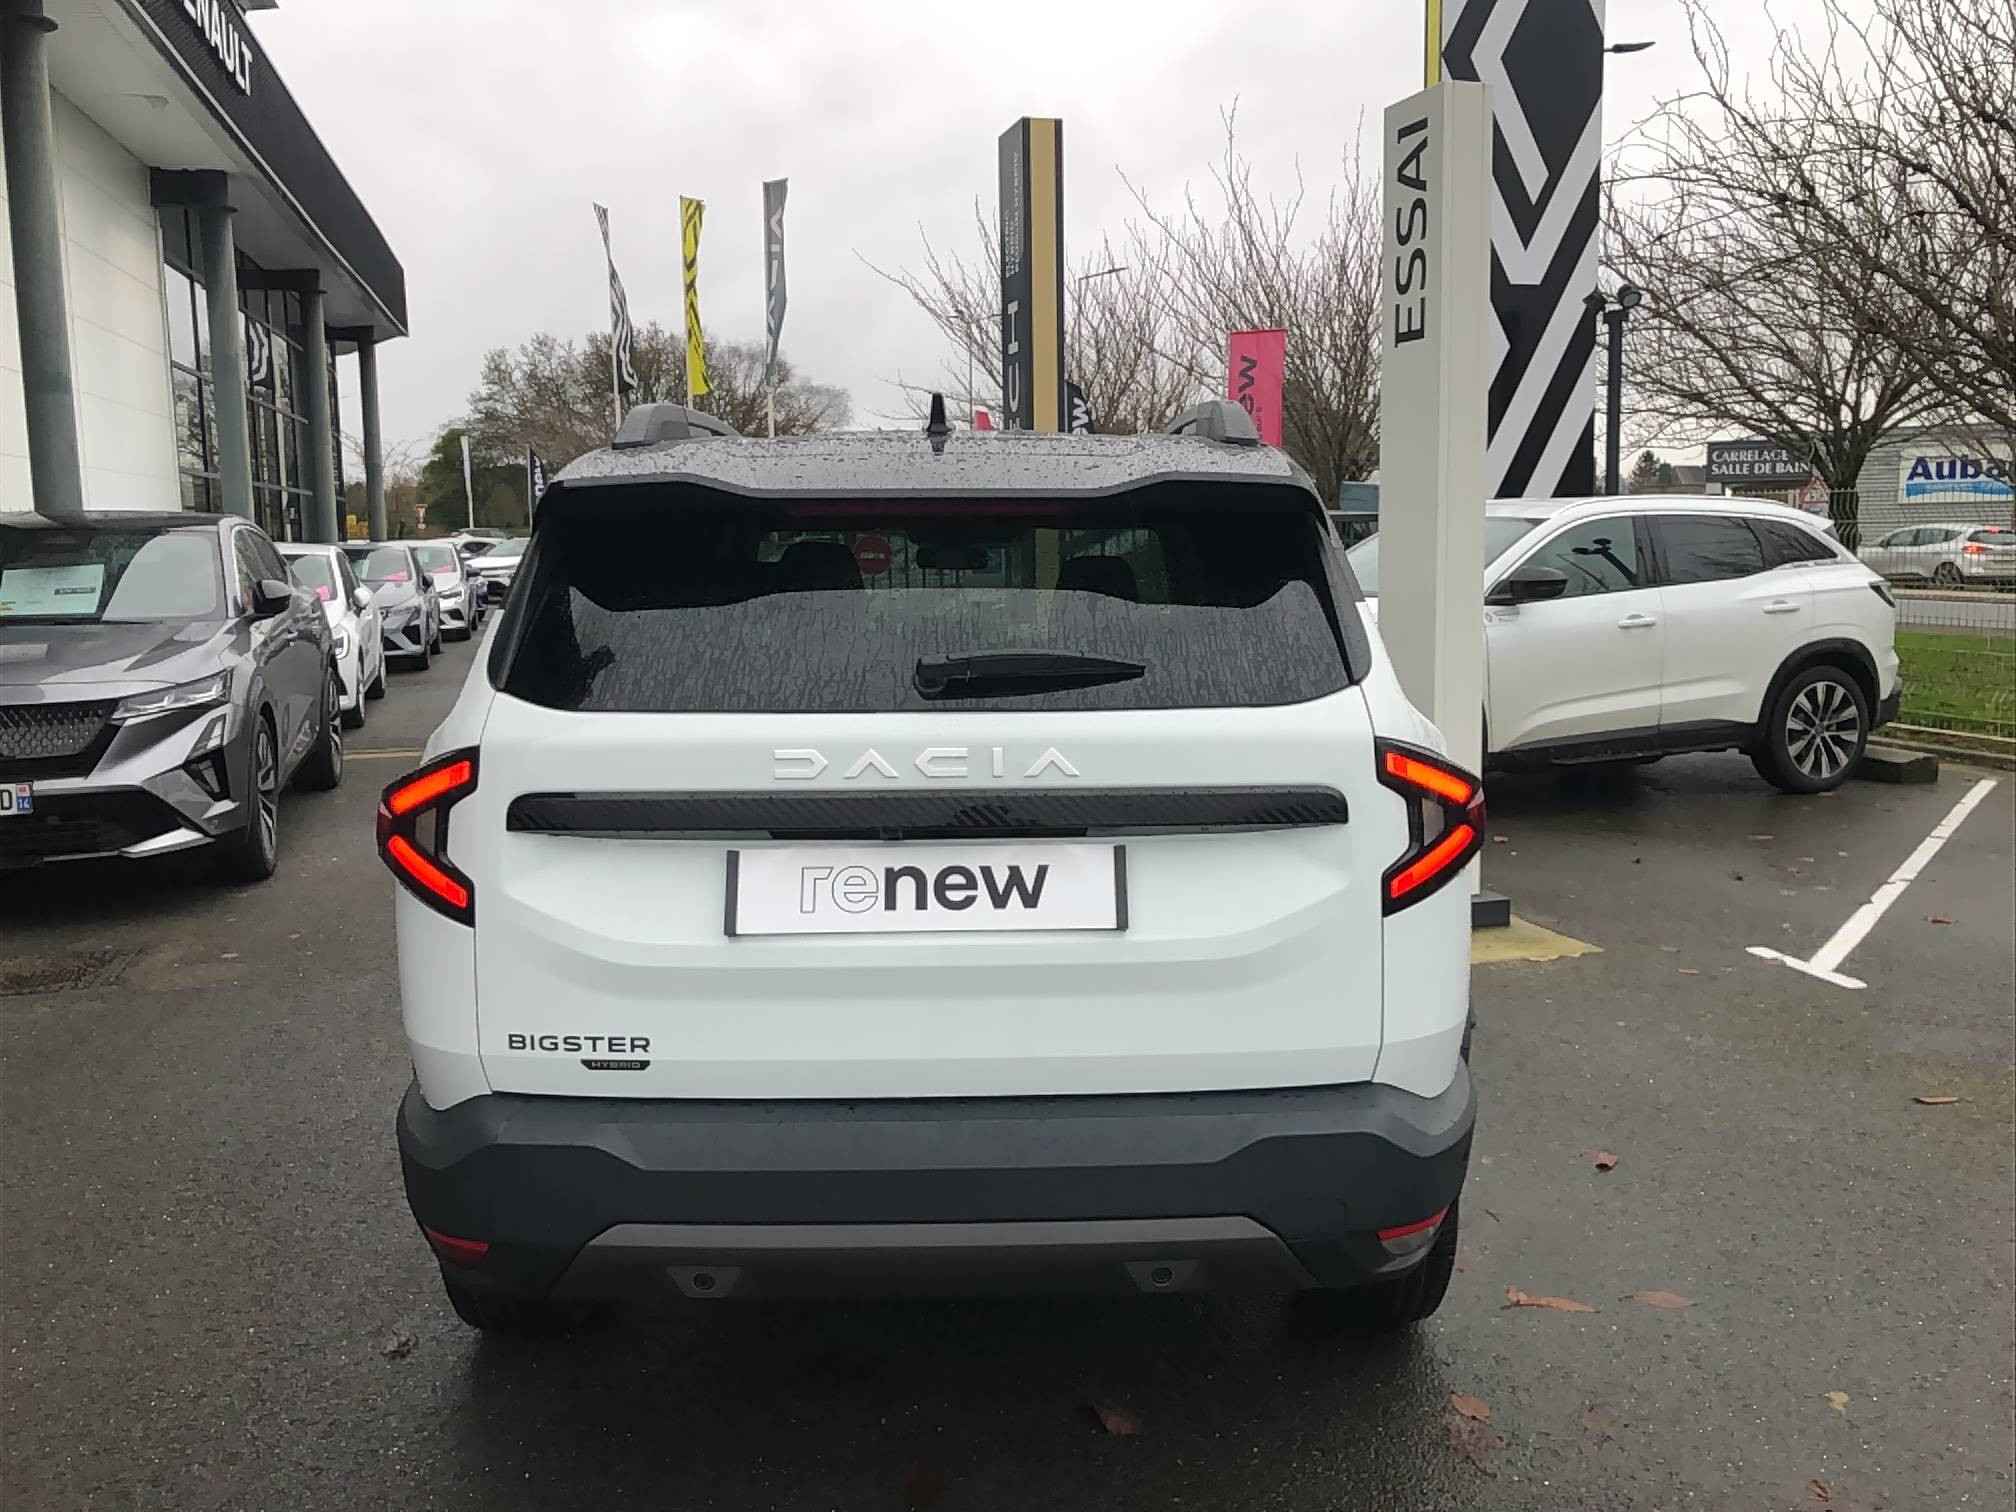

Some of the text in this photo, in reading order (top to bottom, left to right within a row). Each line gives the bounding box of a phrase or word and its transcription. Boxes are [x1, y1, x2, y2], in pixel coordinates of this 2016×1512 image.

[183, 0, 253, 96] NAULT
[1395, 117, 1429, 347] ESSAI
[1711, 449, 1789, 463] CARRELAGE
[1711, 463, 1749, 475] SALLE
[1754, 463, 1772, 474] DE
[773, 747, 1081, 779] DACIA
[800, 864, 1050, 914] renew
[508, 1033, 651, 1053] BIGSTER
[591, 1061, 641, 1069] HYBRID
